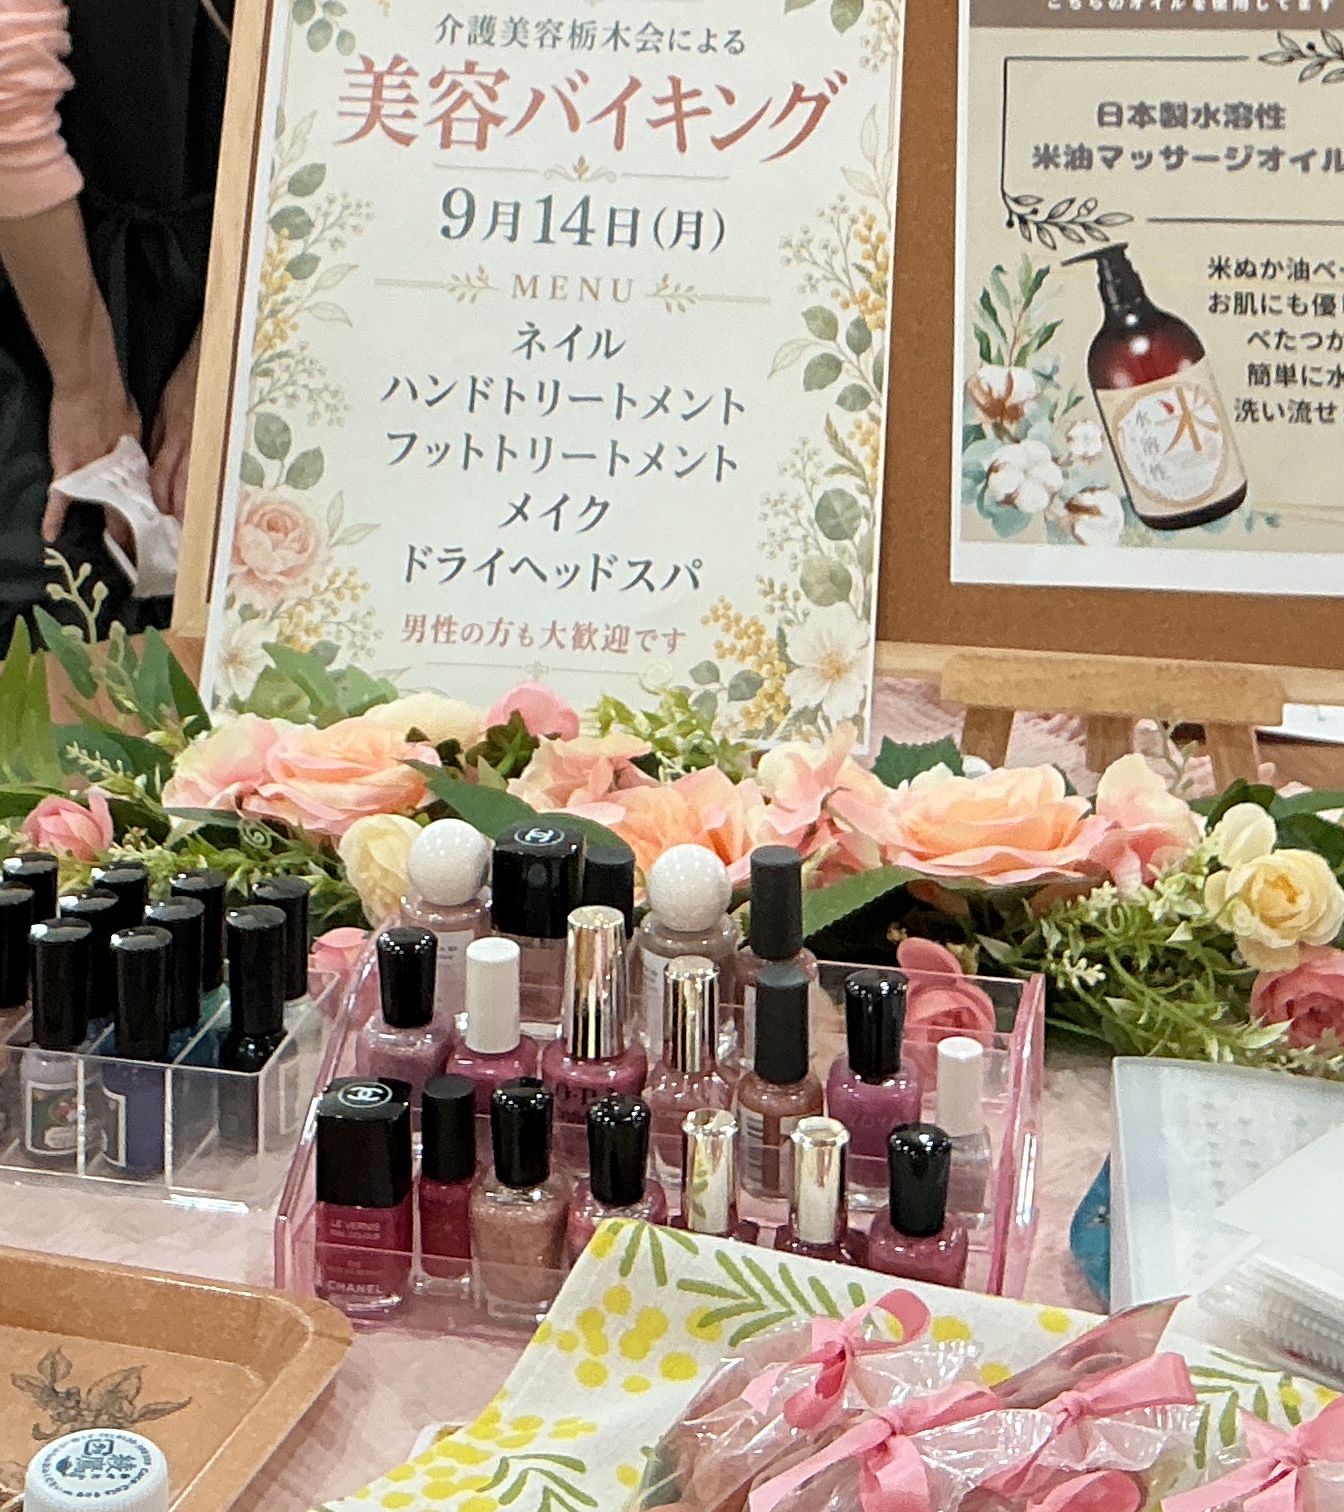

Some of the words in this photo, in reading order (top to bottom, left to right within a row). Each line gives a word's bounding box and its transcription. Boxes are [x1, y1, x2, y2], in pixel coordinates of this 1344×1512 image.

[435, 13, 746, 55] 介護美容栃木会による
[334, 53, 849, 163] 美容バイキング
[1096, 100, 1287, 131] 日本製水溶性
[511, 274, 635, 305] MENU
[511, 322, 627, 362] ネイル
[379, 375, 747, 426] ハンドトリートメント
[386, 430, 739, 483] フットトリートメント
[497, 492, 611, 533] メイク
[402, 543, 704, 592] ドライヘッドスパ
[402, 614, 687, 655] 男性の方も大歓迎です
